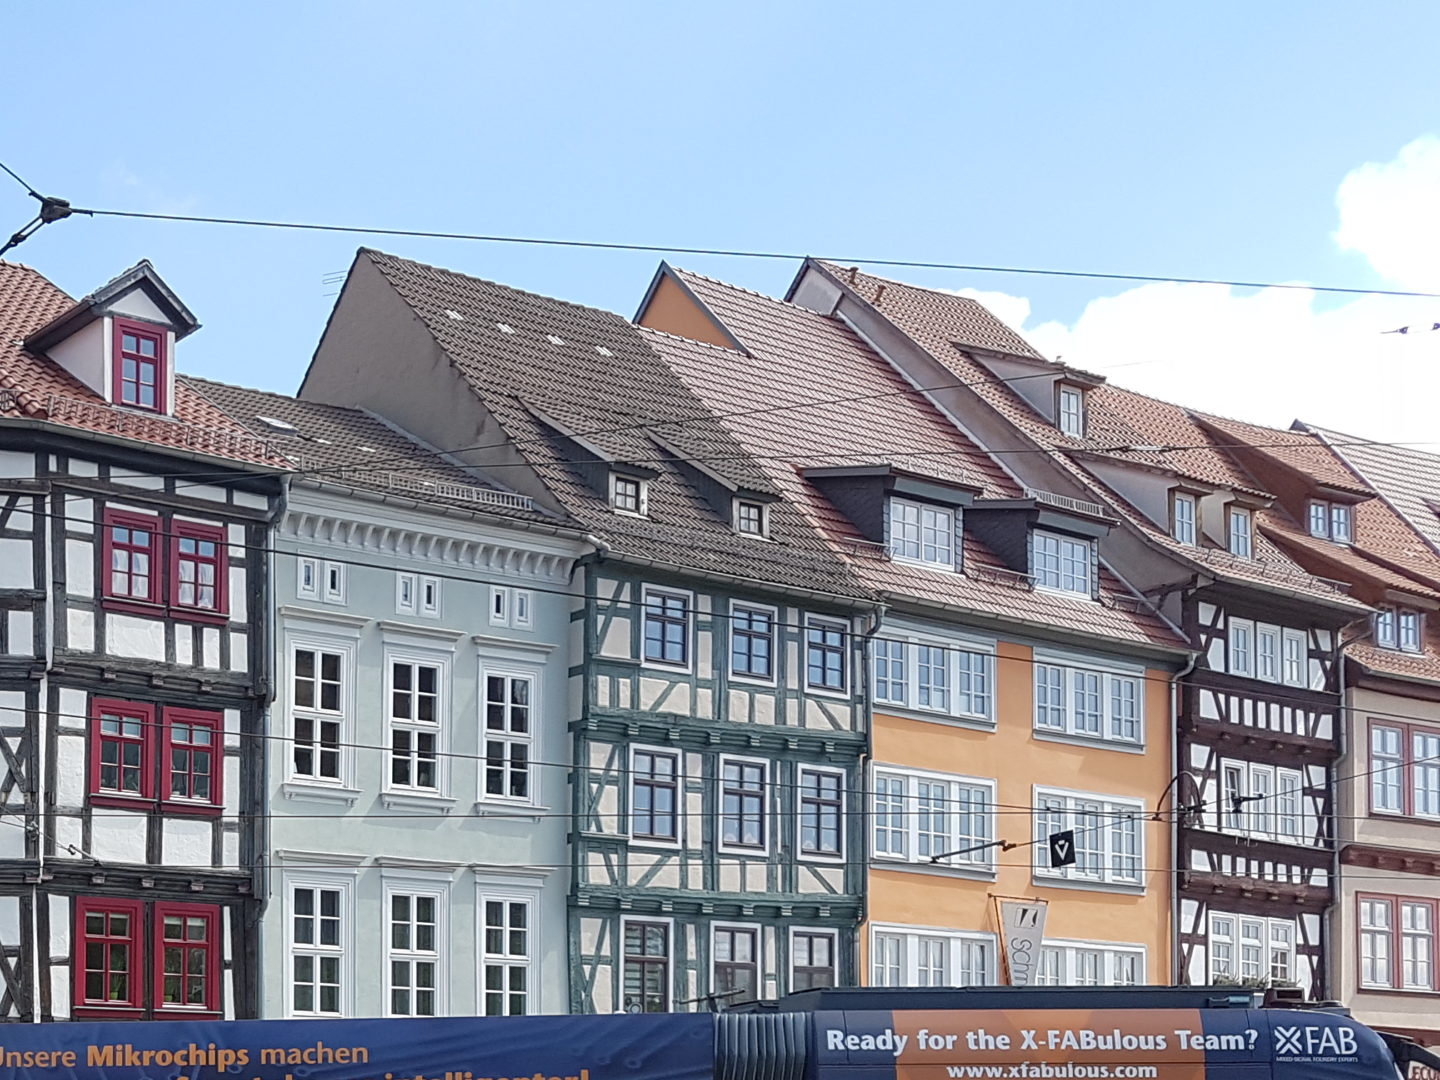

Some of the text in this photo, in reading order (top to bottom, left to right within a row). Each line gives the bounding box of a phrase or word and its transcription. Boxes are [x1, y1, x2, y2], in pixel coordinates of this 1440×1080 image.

[826, 1028, 1259, 1056] Ready for the X-FABulous Team?
[86, 1043, 250, 1073] Mikrochips
[260, 1041, 369, 1065] machen
[946, 1061, 1158, 1079] www.xfabulous.com
